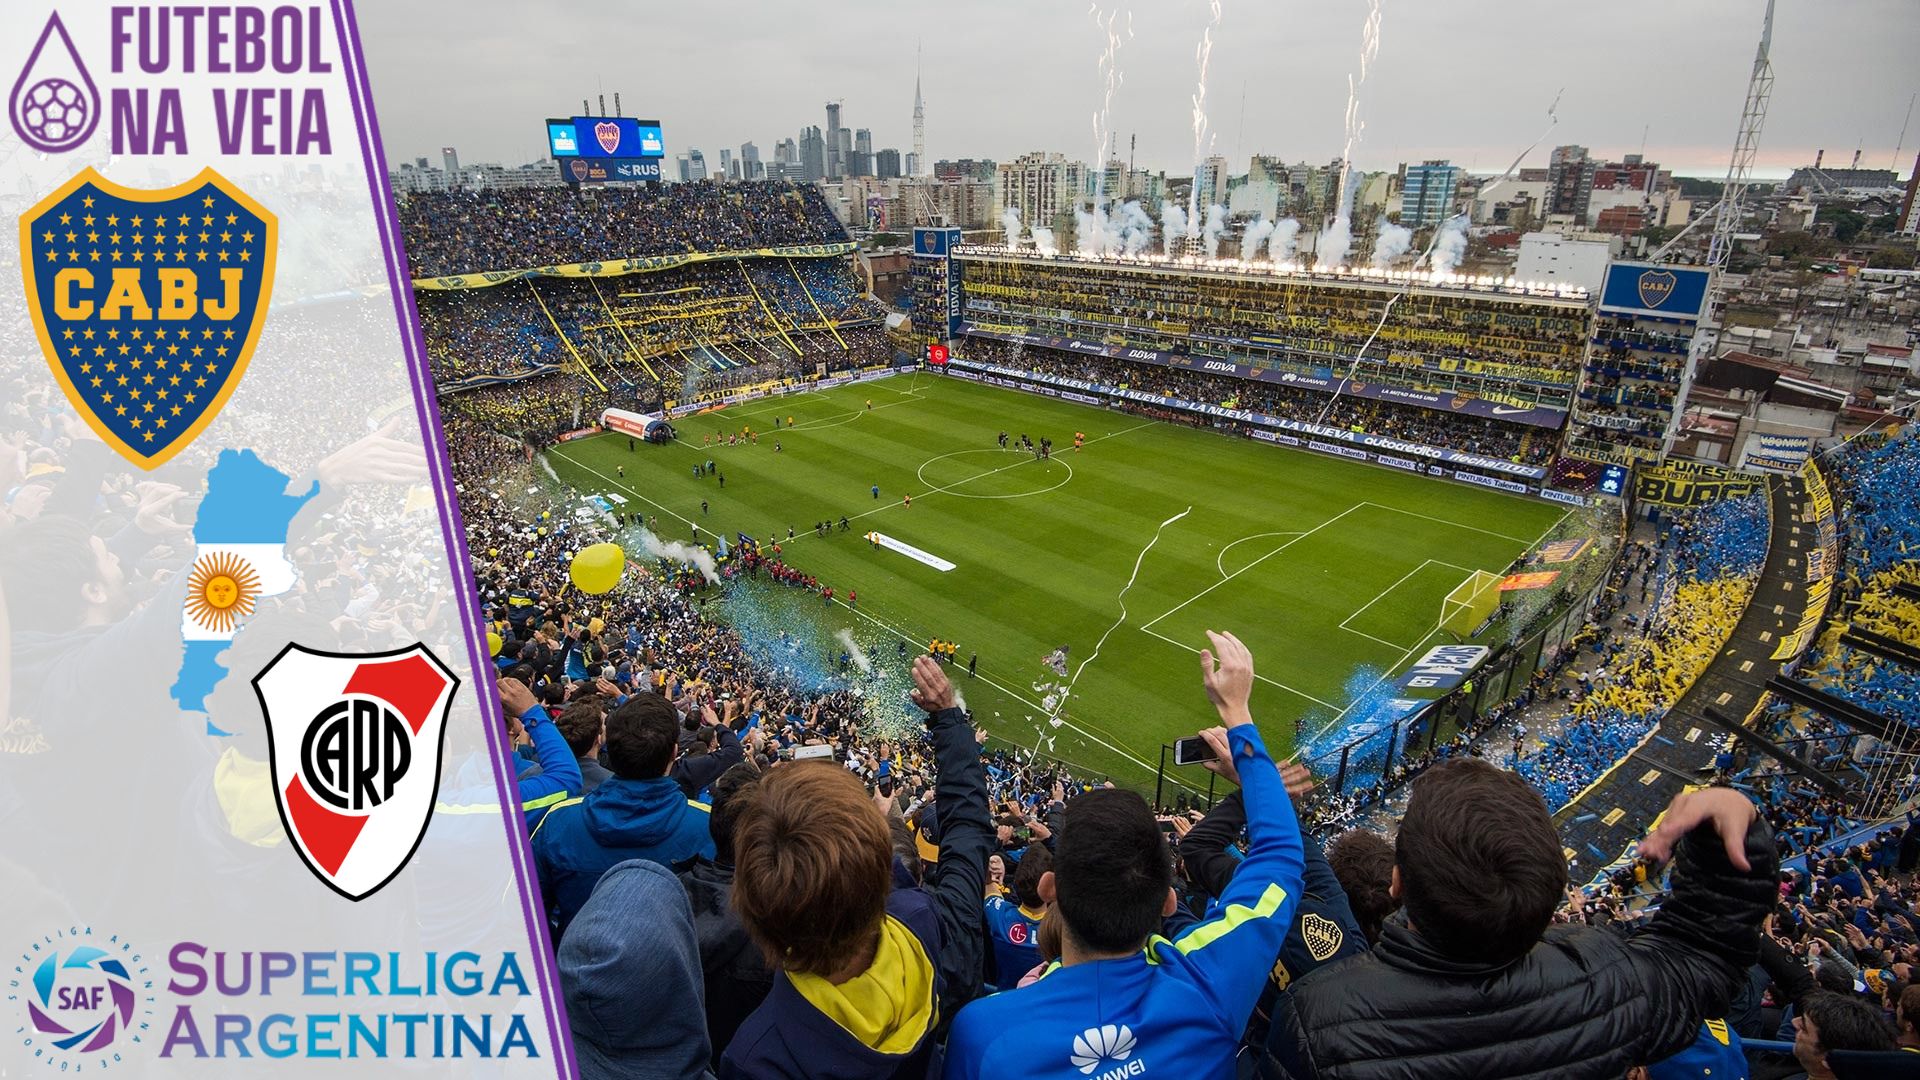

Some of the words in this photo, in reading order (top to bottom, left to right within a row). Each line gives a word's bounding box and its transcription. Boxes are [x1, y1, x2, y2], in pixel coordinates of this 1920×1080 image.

[633, 164, 659, 176] RUS
[1642, 282, 1671, 292] CABJ
[950, 284, 960, 317] BBVA
[1540, 319, 1571, 332] BOCA
[1480, 339, 1520, 350] LEALTAD
[1129, 349, 1157, 361] BBVA
[1204, 360, 1236, 373] BBVA
[1041, 375, 1057, 384] LA
[1057, 377, 1091, 390] NUEVA
[1297, 376, 1328, 386] HUAWEI
[1109, 388, 1125, 397] LA
[1126, 390, 1166, 404] NUEVA
[1188, 402, 1207, 413] LA
[1207, 405, 1253, 421] NUEVA
[1279, 419, 1300, 430] LA
[1301, 424, 1355, 440] NUEVA
[1605, 416, 1641, 431] FAMILIA
[1311, 442, 1339, 453] PINTURAS
[1340, 447, 1365, 459] Talento
[1364, 437, 1442, 458] autocrédito
[1379, 456, 1412, 468] PINTURAS
[1567, 445, 1631, 467] PATERNAL
[1746, 454, 1800, 471] VERSAILLES
[1640, 466, 1667, 477] BELLA
[1667, 469, 1690, 480] VISTA
[1663, 459, 1729, 479] FUNES
[1457, 473, 1492, 485] PINTURAS
[1494, 480, 1524, 492] Talento
[1305, 924, 1336, 945] CABJ
